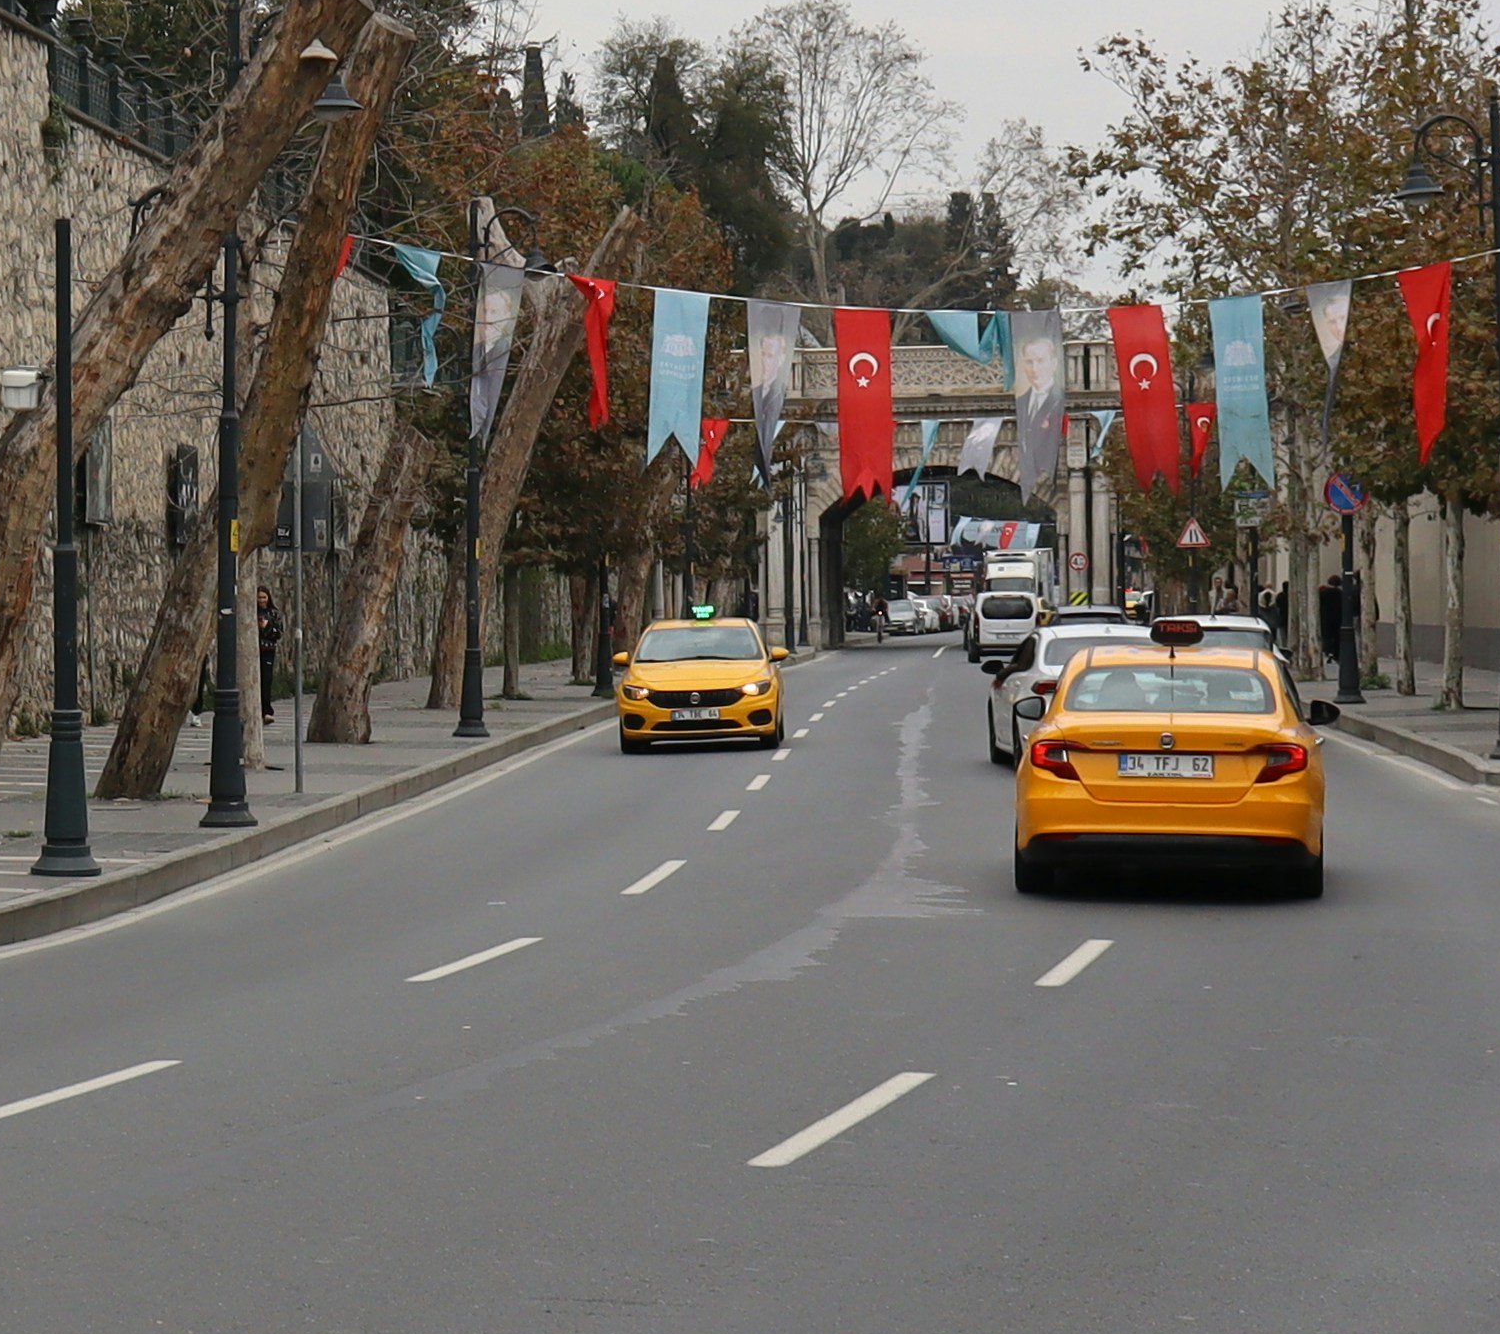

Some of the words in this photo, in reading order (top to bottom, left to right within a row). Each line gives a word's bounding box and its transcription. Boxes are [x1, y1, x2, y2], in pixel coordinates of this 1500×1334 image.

[1128, 757, 1144, 771] 34
[1154, 756, 1179, 771] TFJ
[1192, 757, 1209, 772] 62
